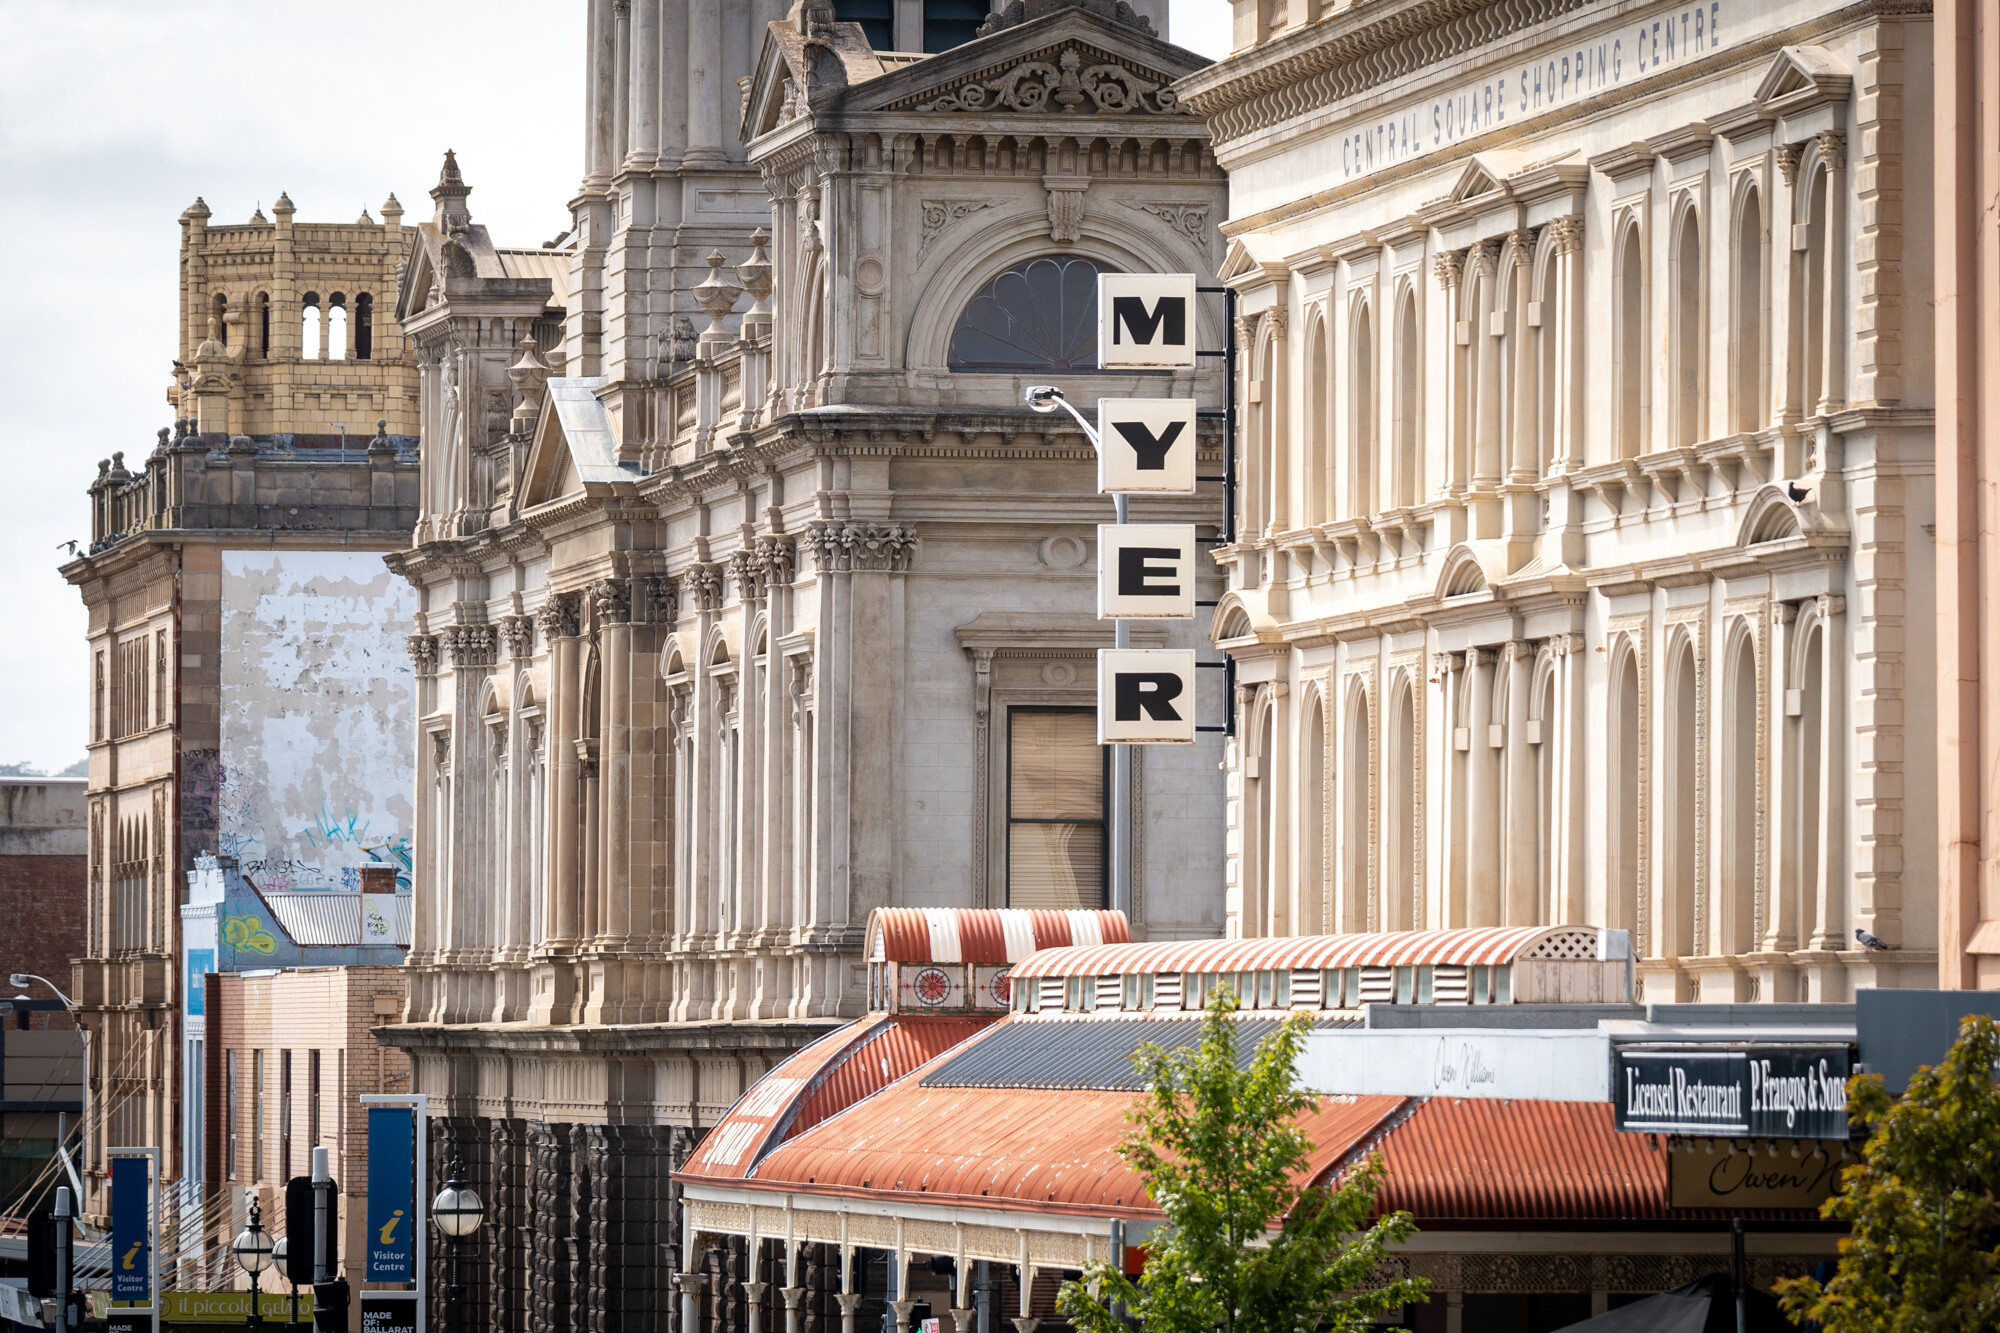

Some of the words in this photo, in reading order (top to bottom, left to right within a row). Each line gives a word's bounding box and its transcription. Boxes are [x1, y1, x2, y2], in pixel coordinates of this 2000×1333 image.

[1343, 112, 1420, 178] CENTRAL
[1433, 79, 1506, 145] SQUARE
[1520, 38, 1621, 112] SHOPPING
[1639, 1, 1719, 74] CENTRE
[1807, 1065, 1818, 1111] &
[1818, 1058, 1847, 1112] Sons
[1626, 1065, 1675, 1116] Licensed
[1675, 1067, 1742, 1118] Restaurant
[1709, 1148, 1807, 1196] Owen
[373, 1251, 406, 1260] Visitor
[373, 1262, 405, 1271] Centre
[117, 1275, 144, 1283] Visitor
[117, 1284, 144, 1292] Centre
[178, 1297, 188, 1313] il
[363, 1311, 393, 1320] MADE
